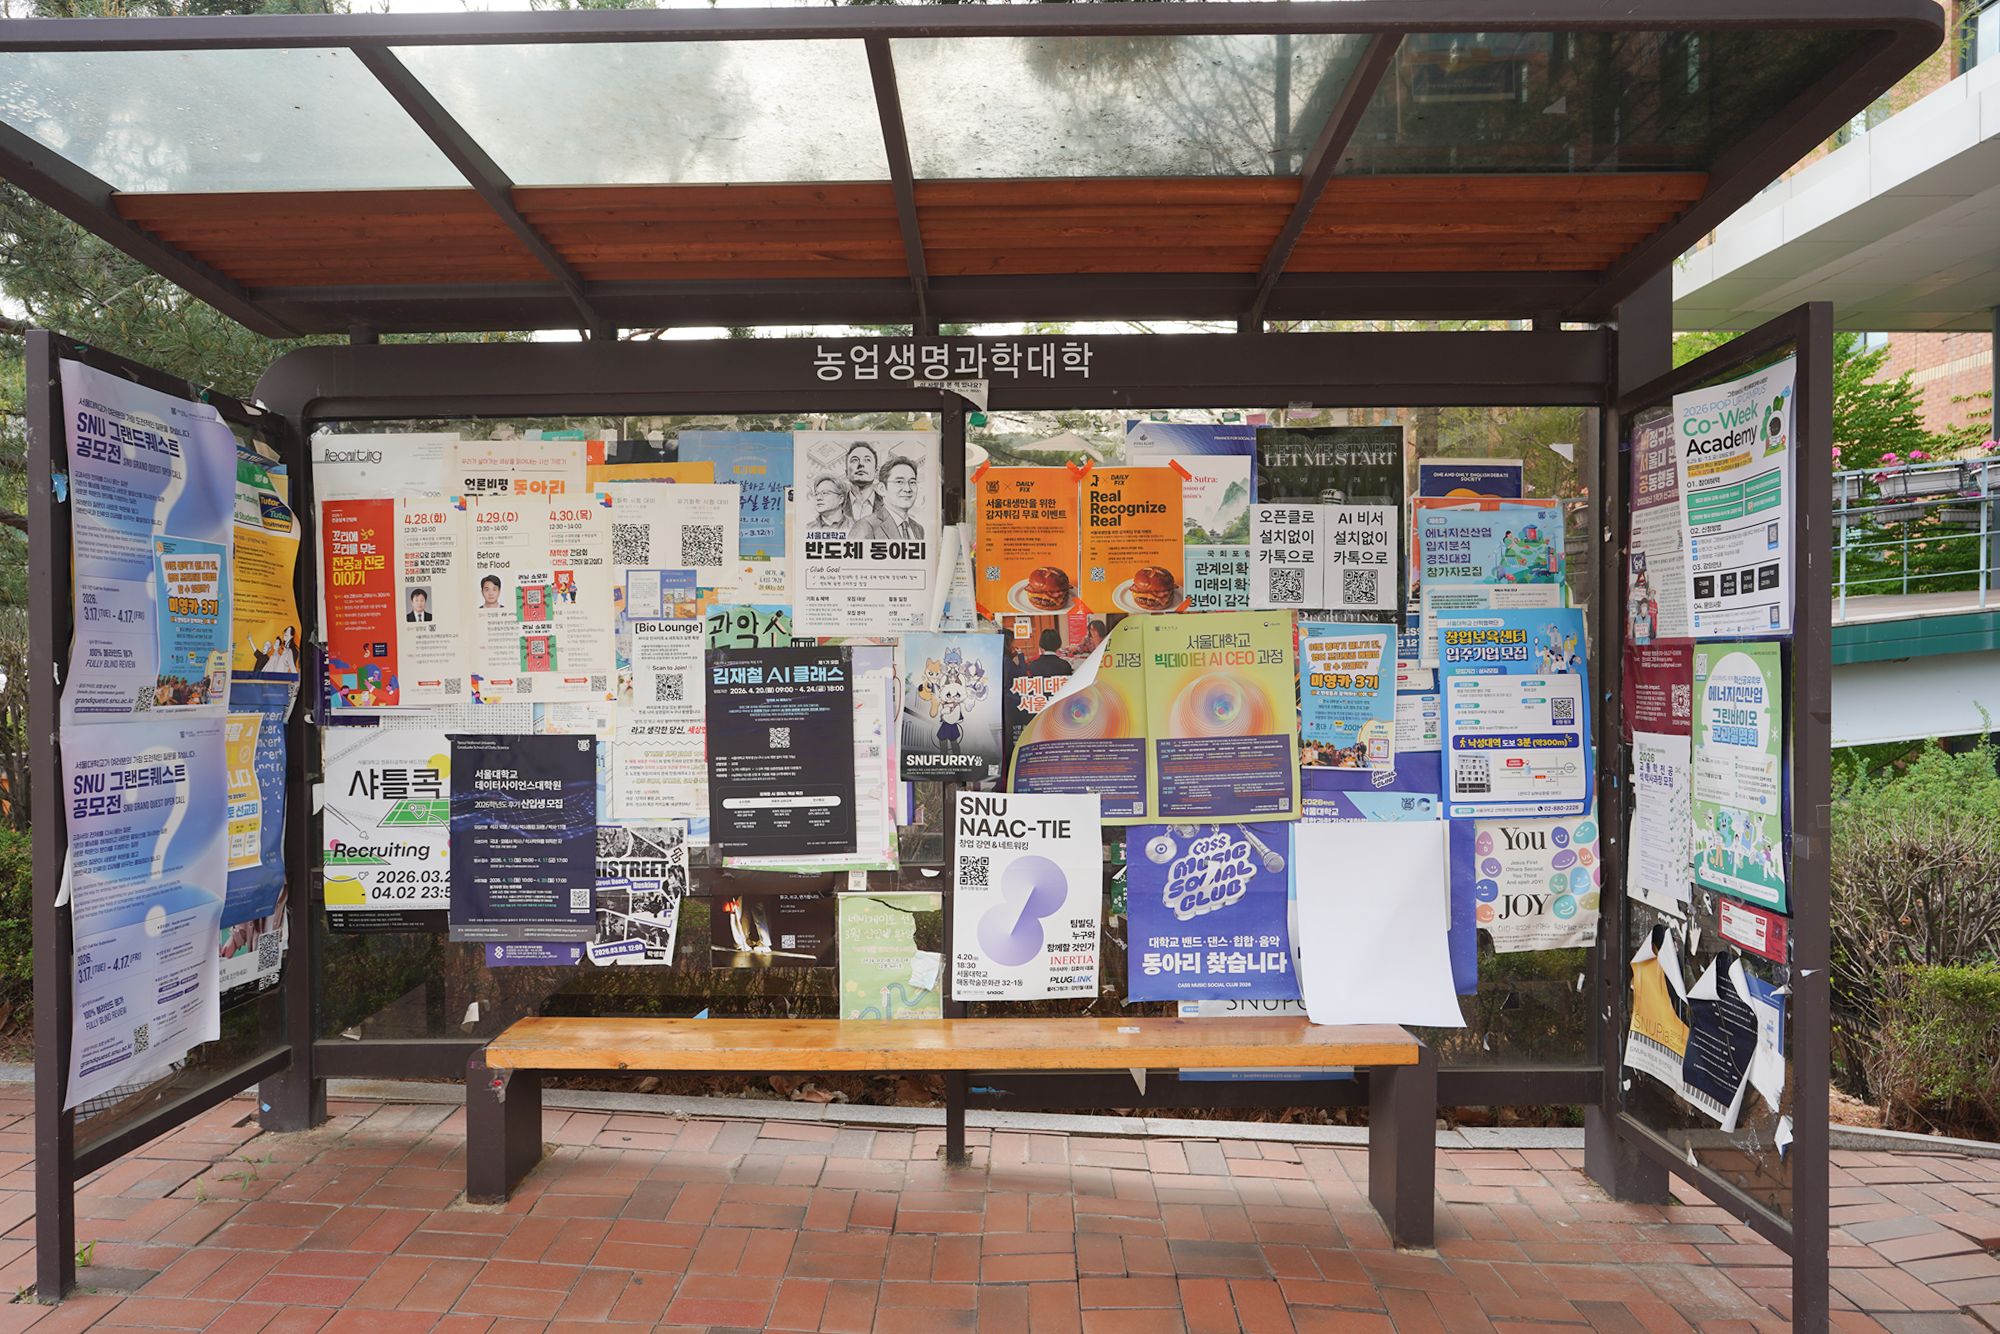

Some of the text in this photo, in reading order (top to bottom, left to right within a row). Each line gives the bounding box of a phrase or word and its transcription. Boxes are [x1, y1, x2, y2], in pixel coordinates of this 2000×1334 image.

[814, 342, 1093, 380] 농업생명과학대학
[1683, 398, 1732, 418] 2026 POP
[1683, 400, 1758, 439] Co-Week
[77, 412, 180, 458] SNU 그랜드퀘스트
[1686, 424, 1758, 458] Academy
[76, 435, 122, 464] 공모전
[1194, 475, 1218, 484] Sutra:
[464, 478, 566, 496] 언론비평 동아리
[986, 498, 1056, 508] 서울대생만을 위한
[1090, 490, 1121, 502] Real
[986, 510, 1067, 520] 감자튀김 무료 이벤트
[1090, 502, 1166, 515] Recognize
[404, 513, 447, 525] 4.28.(화)
[476, 512, 518, 524] 4.29.(수)
[1090, 515, 1122, 526] Real
[1260, 510, 1315, 524] 오픈클로
[1338, 511, 1384, 526] AI 비서
[806, 532, 846, 540] 서울대학교
[1259, 530, 1314, 545] 설치없이
[1334, 530, 1388, 546] 설치없이
[1426, 528, 1492, 538] 에너지신산업
[806, 542, 926, 560] 반도체 동아리
[1426, 540, 1470, 552] 입지분석
[476, 552, 500, 560] Before
[1259, 549, 1315, 564] 카톡으로
[1333, 550, 1388, 566] 카톡으로
[1426, 554, 1471, 564] 경진대회
[476, 561, 510, 569] the Flood
[1196, 562, 1234, 576] 관계의
[1426, 566, 1482, 578] 참가자모집
[332, 571, 366, 587] 이야기
[1195, 579, 1232, 592] 미래의
[84, 606, 134, 624] 3.17. 4.17.
[634, 622, 703, 634] [Bio Lounge]
[1186, 633, 1250, 650] 서울대학교
[1445, 630, 1527, 645] 창업보육센터
[1115, 652, 1142, 668] 과정
[1154, 650, 1284, 668] 빅데이터 AI CEO 과정
[1446, 646, 1528, 662] 입주기업 모집
[713, 666, 844, 685] 김재철 AI 클래스
[1310, 674, 1379, 690] 미영카 3기
[1012, 676, 1044, 695] 세계
[1708, 685, 1764, 704] 에너지신산업
[1712, 708, 1758, 726] 그린바이오
[631, 726, 645, 735] 라고
[646, 726, 668, 735] 생각한
[1468, 738, 1568, 748] 낙성대역 도보 3분 (약300m)
[906, 754, 975, 766] SNUFURRY
[74, 764, 186, 795] SNU 그랜드퀘스트
[474, 770, 518, 780] 서울대학교
[348, 768, 442, 800] 샤틀콕
[474, 780, 562, 792] 데이터사이언스대학원
[73, 794, 122, 820] 공모전
[521, 799, 546, 809] 신입생
[546, 798, 564, 809] 모집
[960, 797, 1007, 816] SNU
[1544, 804, 1579, 812] 02-880-2226
[960, 818, 1070, 838] NAAC-TIE
[960, 840, 974, 848] 창업
[976, 840, 991, 849] 강연
[998, 841, 1029, 850] 네트워킹
[1498, 827, 1548, 850] You
[334, 842, 430, 860] Recruiting
[372, 886, 416, 899] 04.02
[1180, 879, 1242, 912] CLUB
[1498, 894, 1551, 920] JOY
[1070, 919, 1096, 928] 팀빌딩,
[1072, 930, 1095, 940] 누구와
[1149, 936, 1180, 948] 대학교
[1047, 942, 1095, 952] 함께할 것인가
[112, 954, 130, 972] 4.17.
[957, 962, 976, 970] 18:30
[1050, 956, 1094, 966] INERTIA
[1142, 952, 1288, 976] 동아리 찾습니다
[957, 970, 988, 978] 서울대학교
[1050, 976, 1092, 984] PLUGLINK
